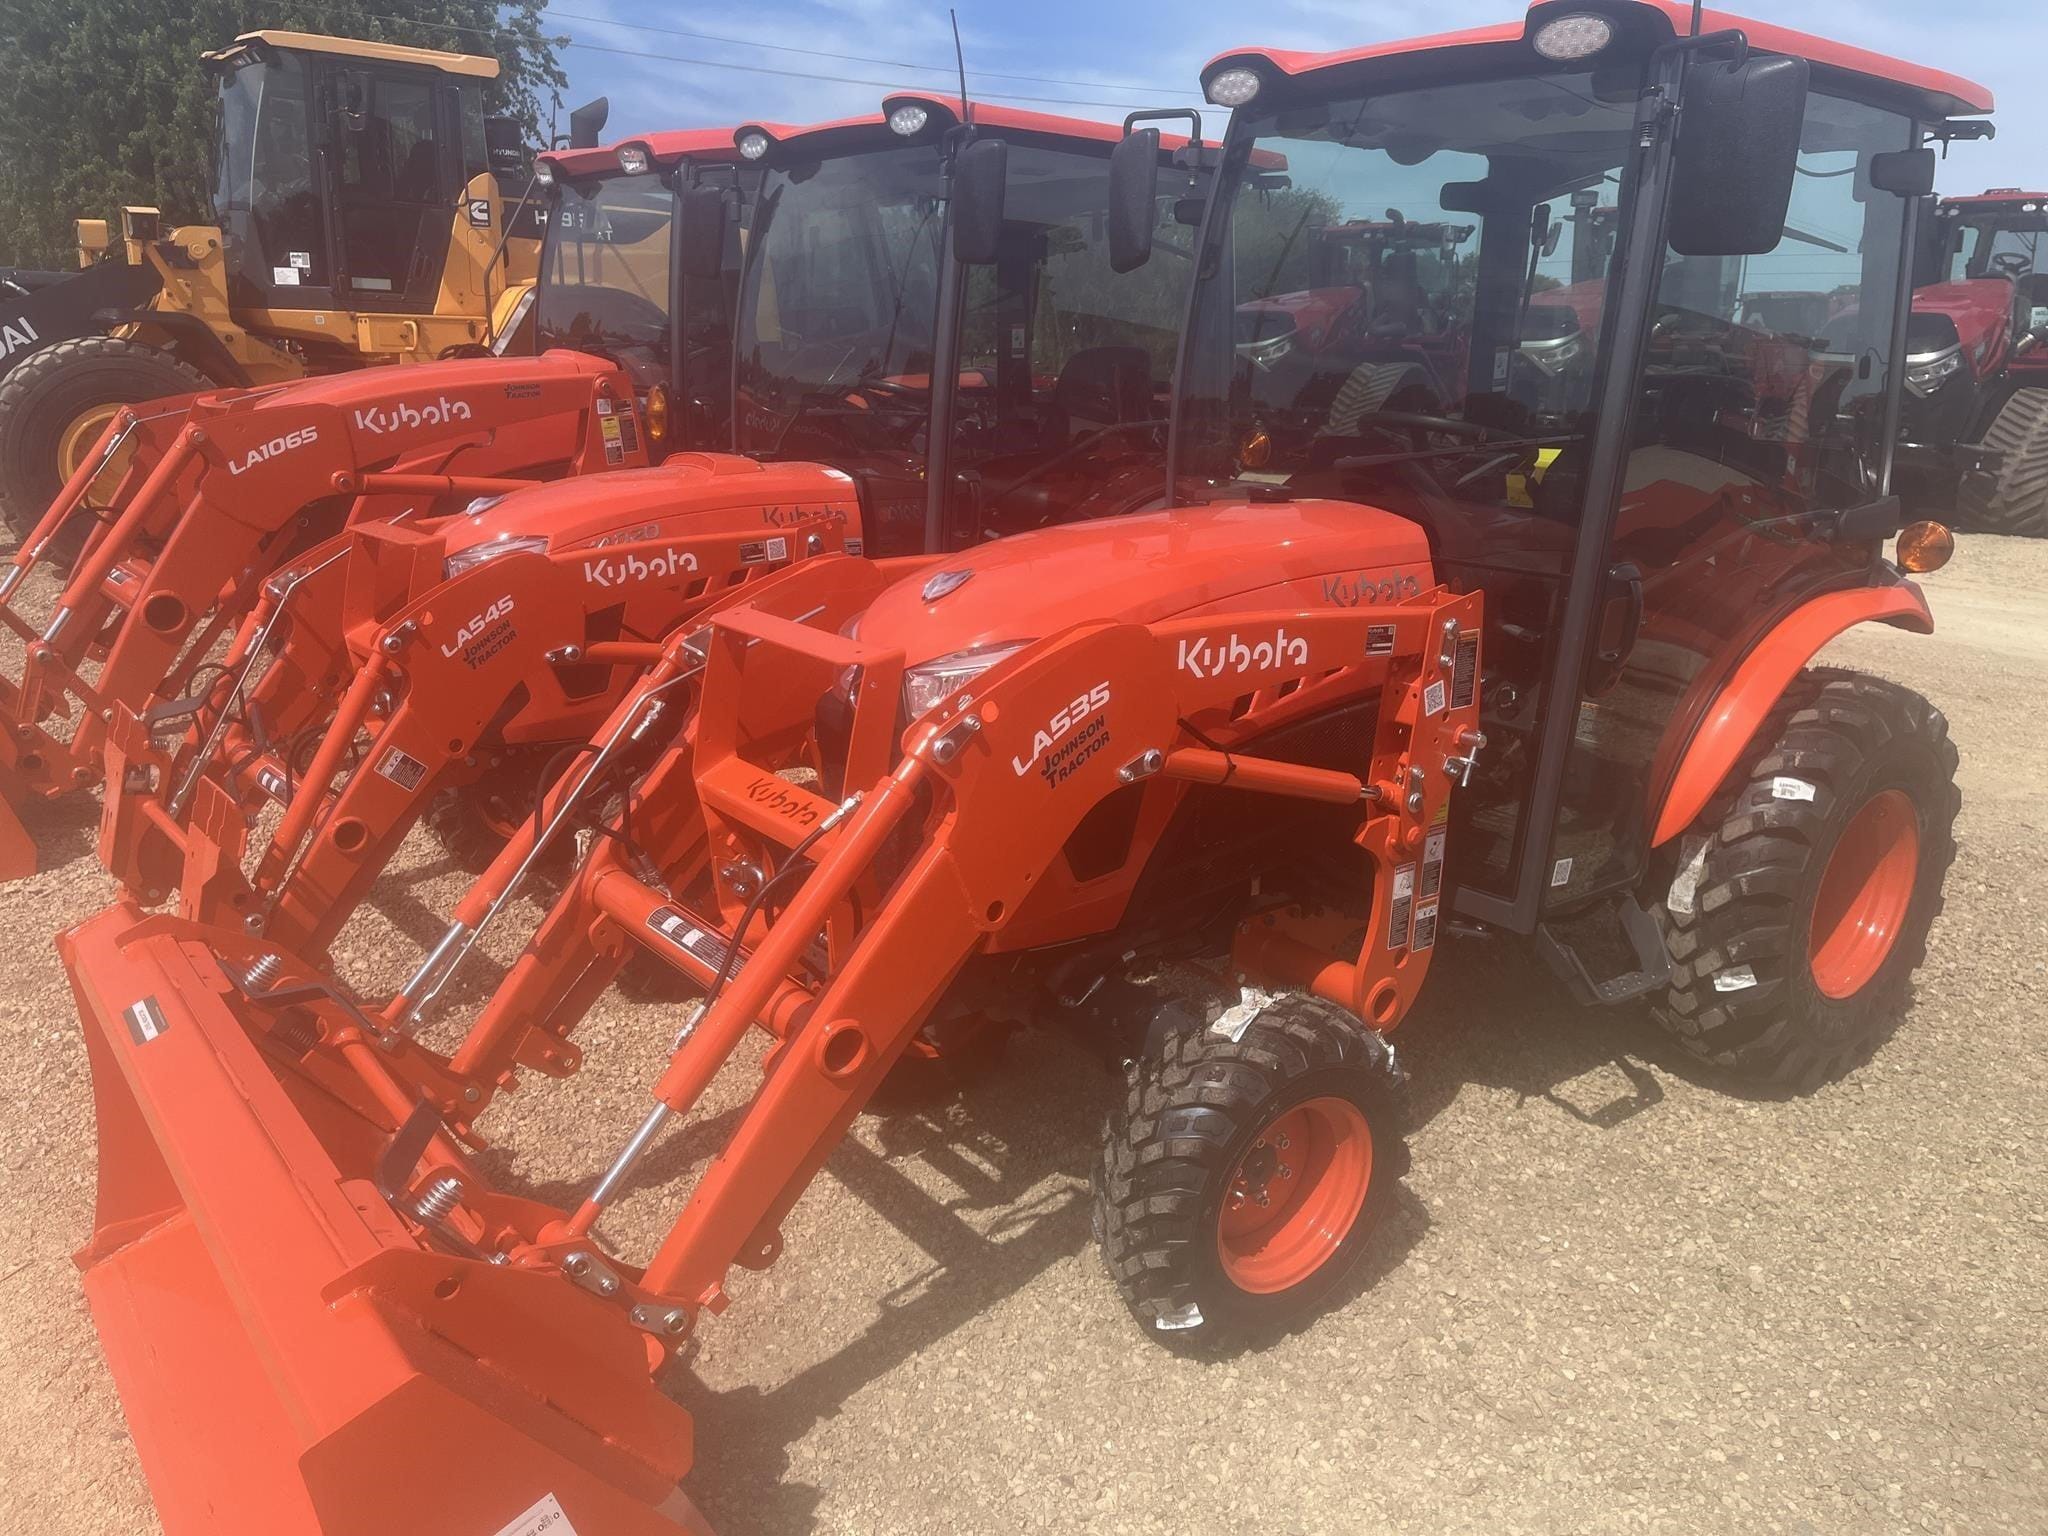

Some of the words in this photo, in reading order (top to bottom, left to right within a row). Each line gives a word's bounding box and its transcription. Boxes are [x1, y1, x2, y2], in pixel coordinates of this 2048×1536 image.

[354, 397, 472, 434] Kubota
[228, 425, 318, 475] LA1065
[763, 504, 847, 528] Kubota
[584, 548, 698, 588] Kubota
[1323, 572, 1419, 608] Kubota
[440, 594, 515, 659] LA545
[463, 619, 512, 664] JOHNSON
[468, 630, 517, 671] TRACTOR
[1178, 628, 1308, 678] Kubota
[1012, 681, 1110, 776] LA535
[1041, 715, 1105, 776] JOHNSON
[1046, 731, 1110, 789] TRACTOR
[746, 777, 818, 825] Kubota
